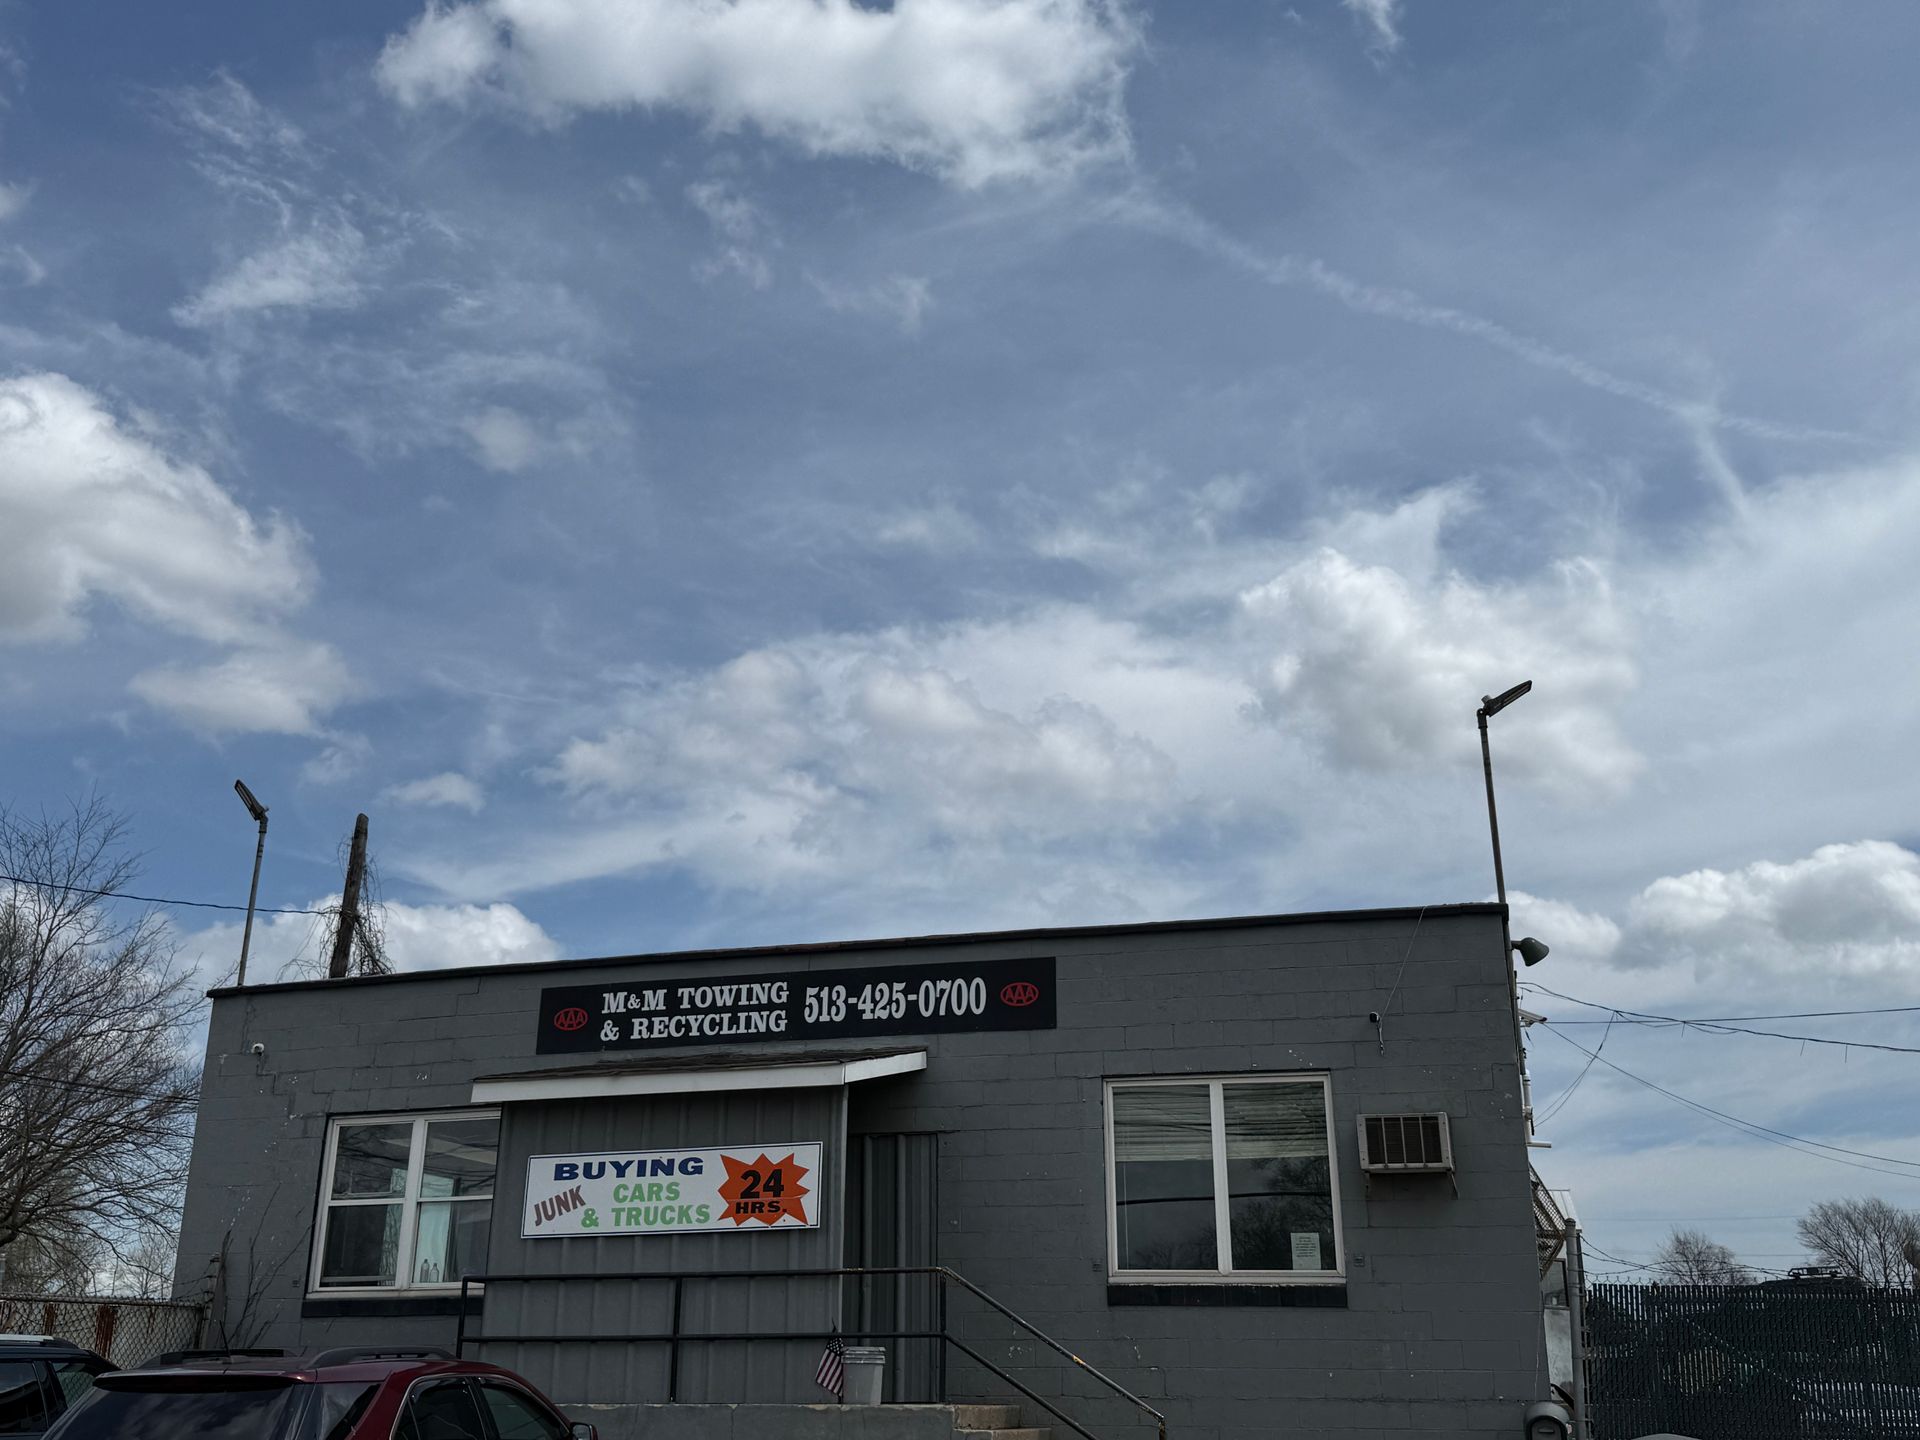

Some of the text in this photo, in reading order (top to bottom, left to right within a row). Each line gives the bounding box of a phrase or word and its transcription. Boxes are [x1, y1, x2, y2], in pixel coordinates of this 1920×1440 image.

[602, 982, 789, 1014] M&M TOWING
[804, 978, 987, 1022] 513-425-0700
[1004, 984, 1038, 1004] AAA
[555, 1009, 587, 1029] AAA
[601, 1010, 787, 1041] & RECYCLING
[553, 1157, 704, 1181] BUYING
[613, 1182, 681, 1203] CARS
[740, 1168, 785, 1199] 24
[534, 1185, 586, 1226] JUNK
[581, 1204, 711, 1228] & TRUCKS
